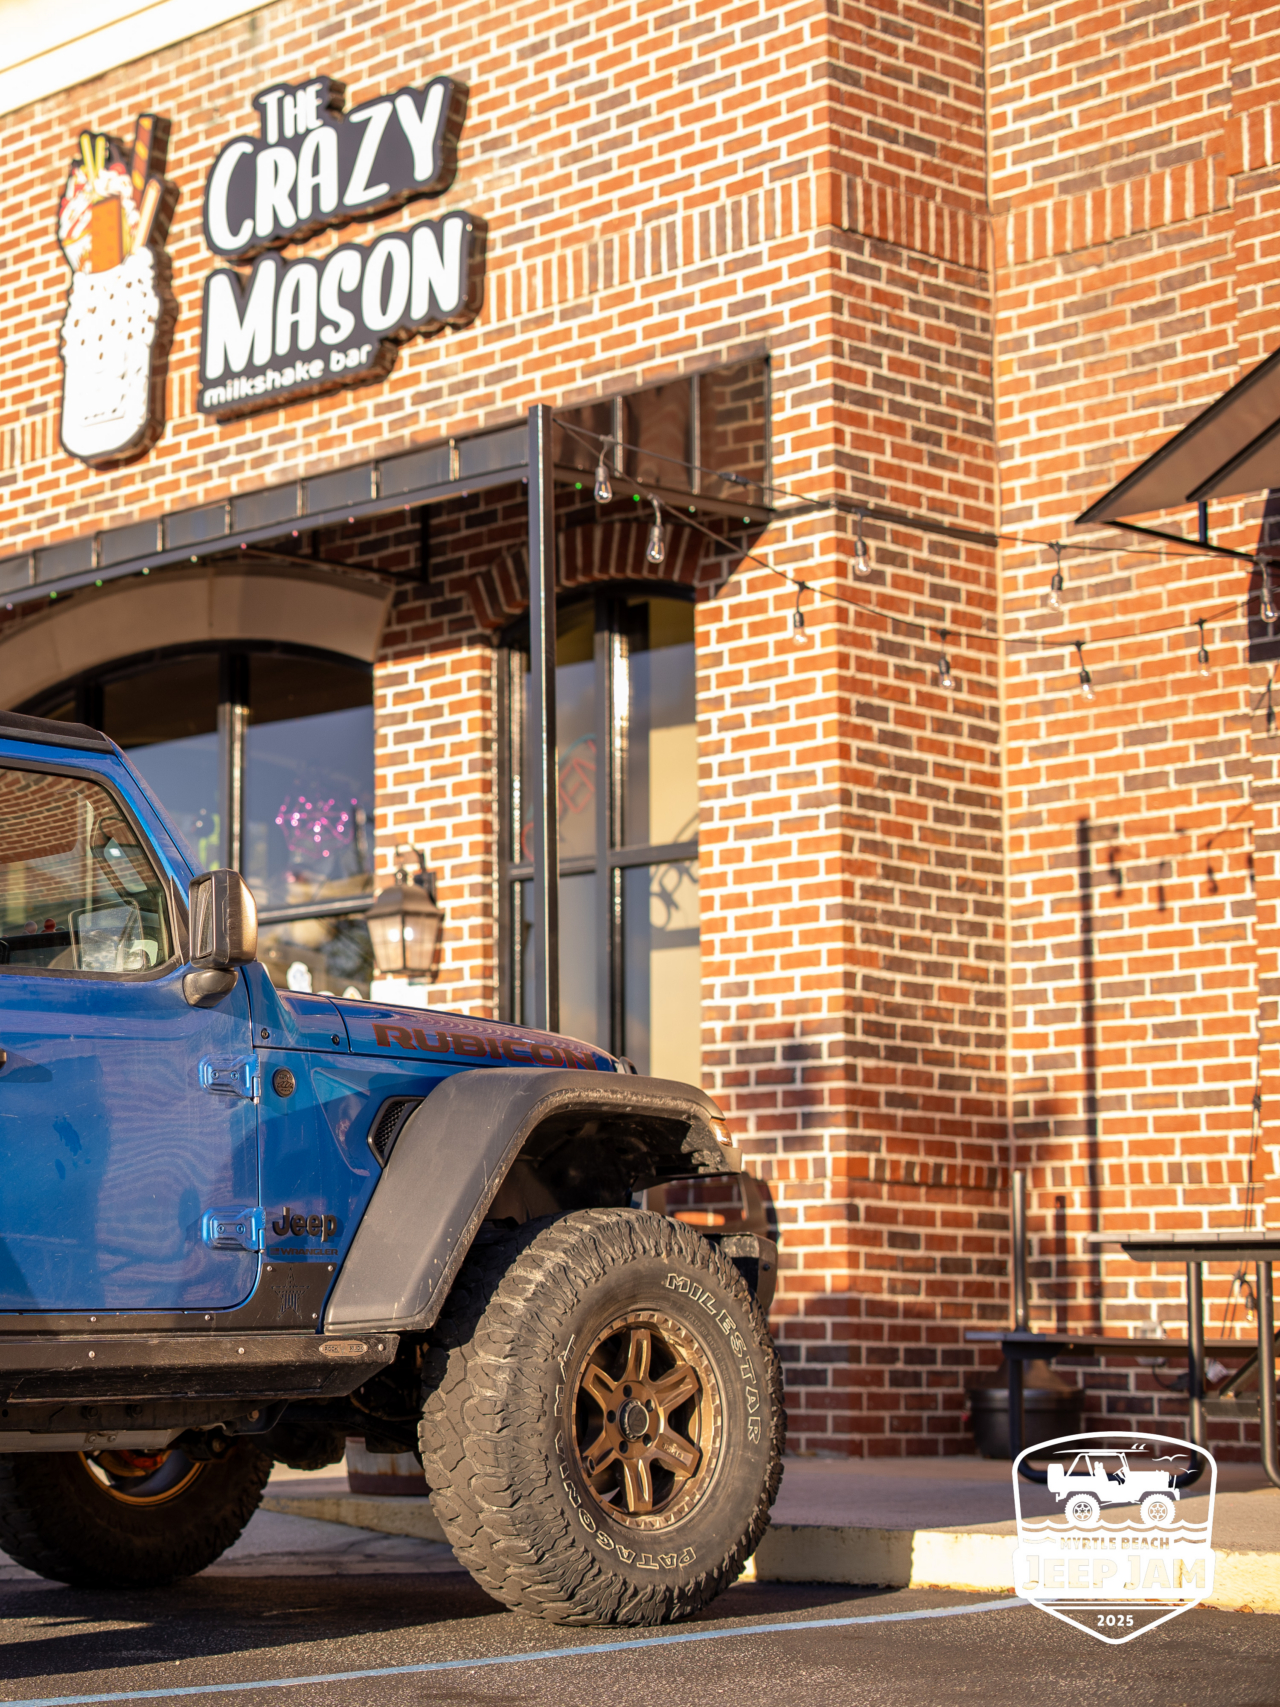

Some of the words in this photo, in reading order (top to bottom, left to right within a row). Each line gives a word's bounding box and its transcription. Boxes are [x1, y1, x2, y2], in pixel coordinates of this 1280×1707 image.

[259, 83, 323, 145] THE
[207, 83, 445, 251] CRAZY
[205, 217, 464, 379] MASON
[203, 358, 325, 408] milkshake
[329, 344, 372, 372] bar
[371, 1023, 598, 1070] RUBICON
[272, 1207, 338, 1242] Jeep
[280, 1247, 338, 1256] WRANGLER
[666, 1273, 762, 1444] MILESTAR
[555, 1430, 696, 1570] PATAGONIA
